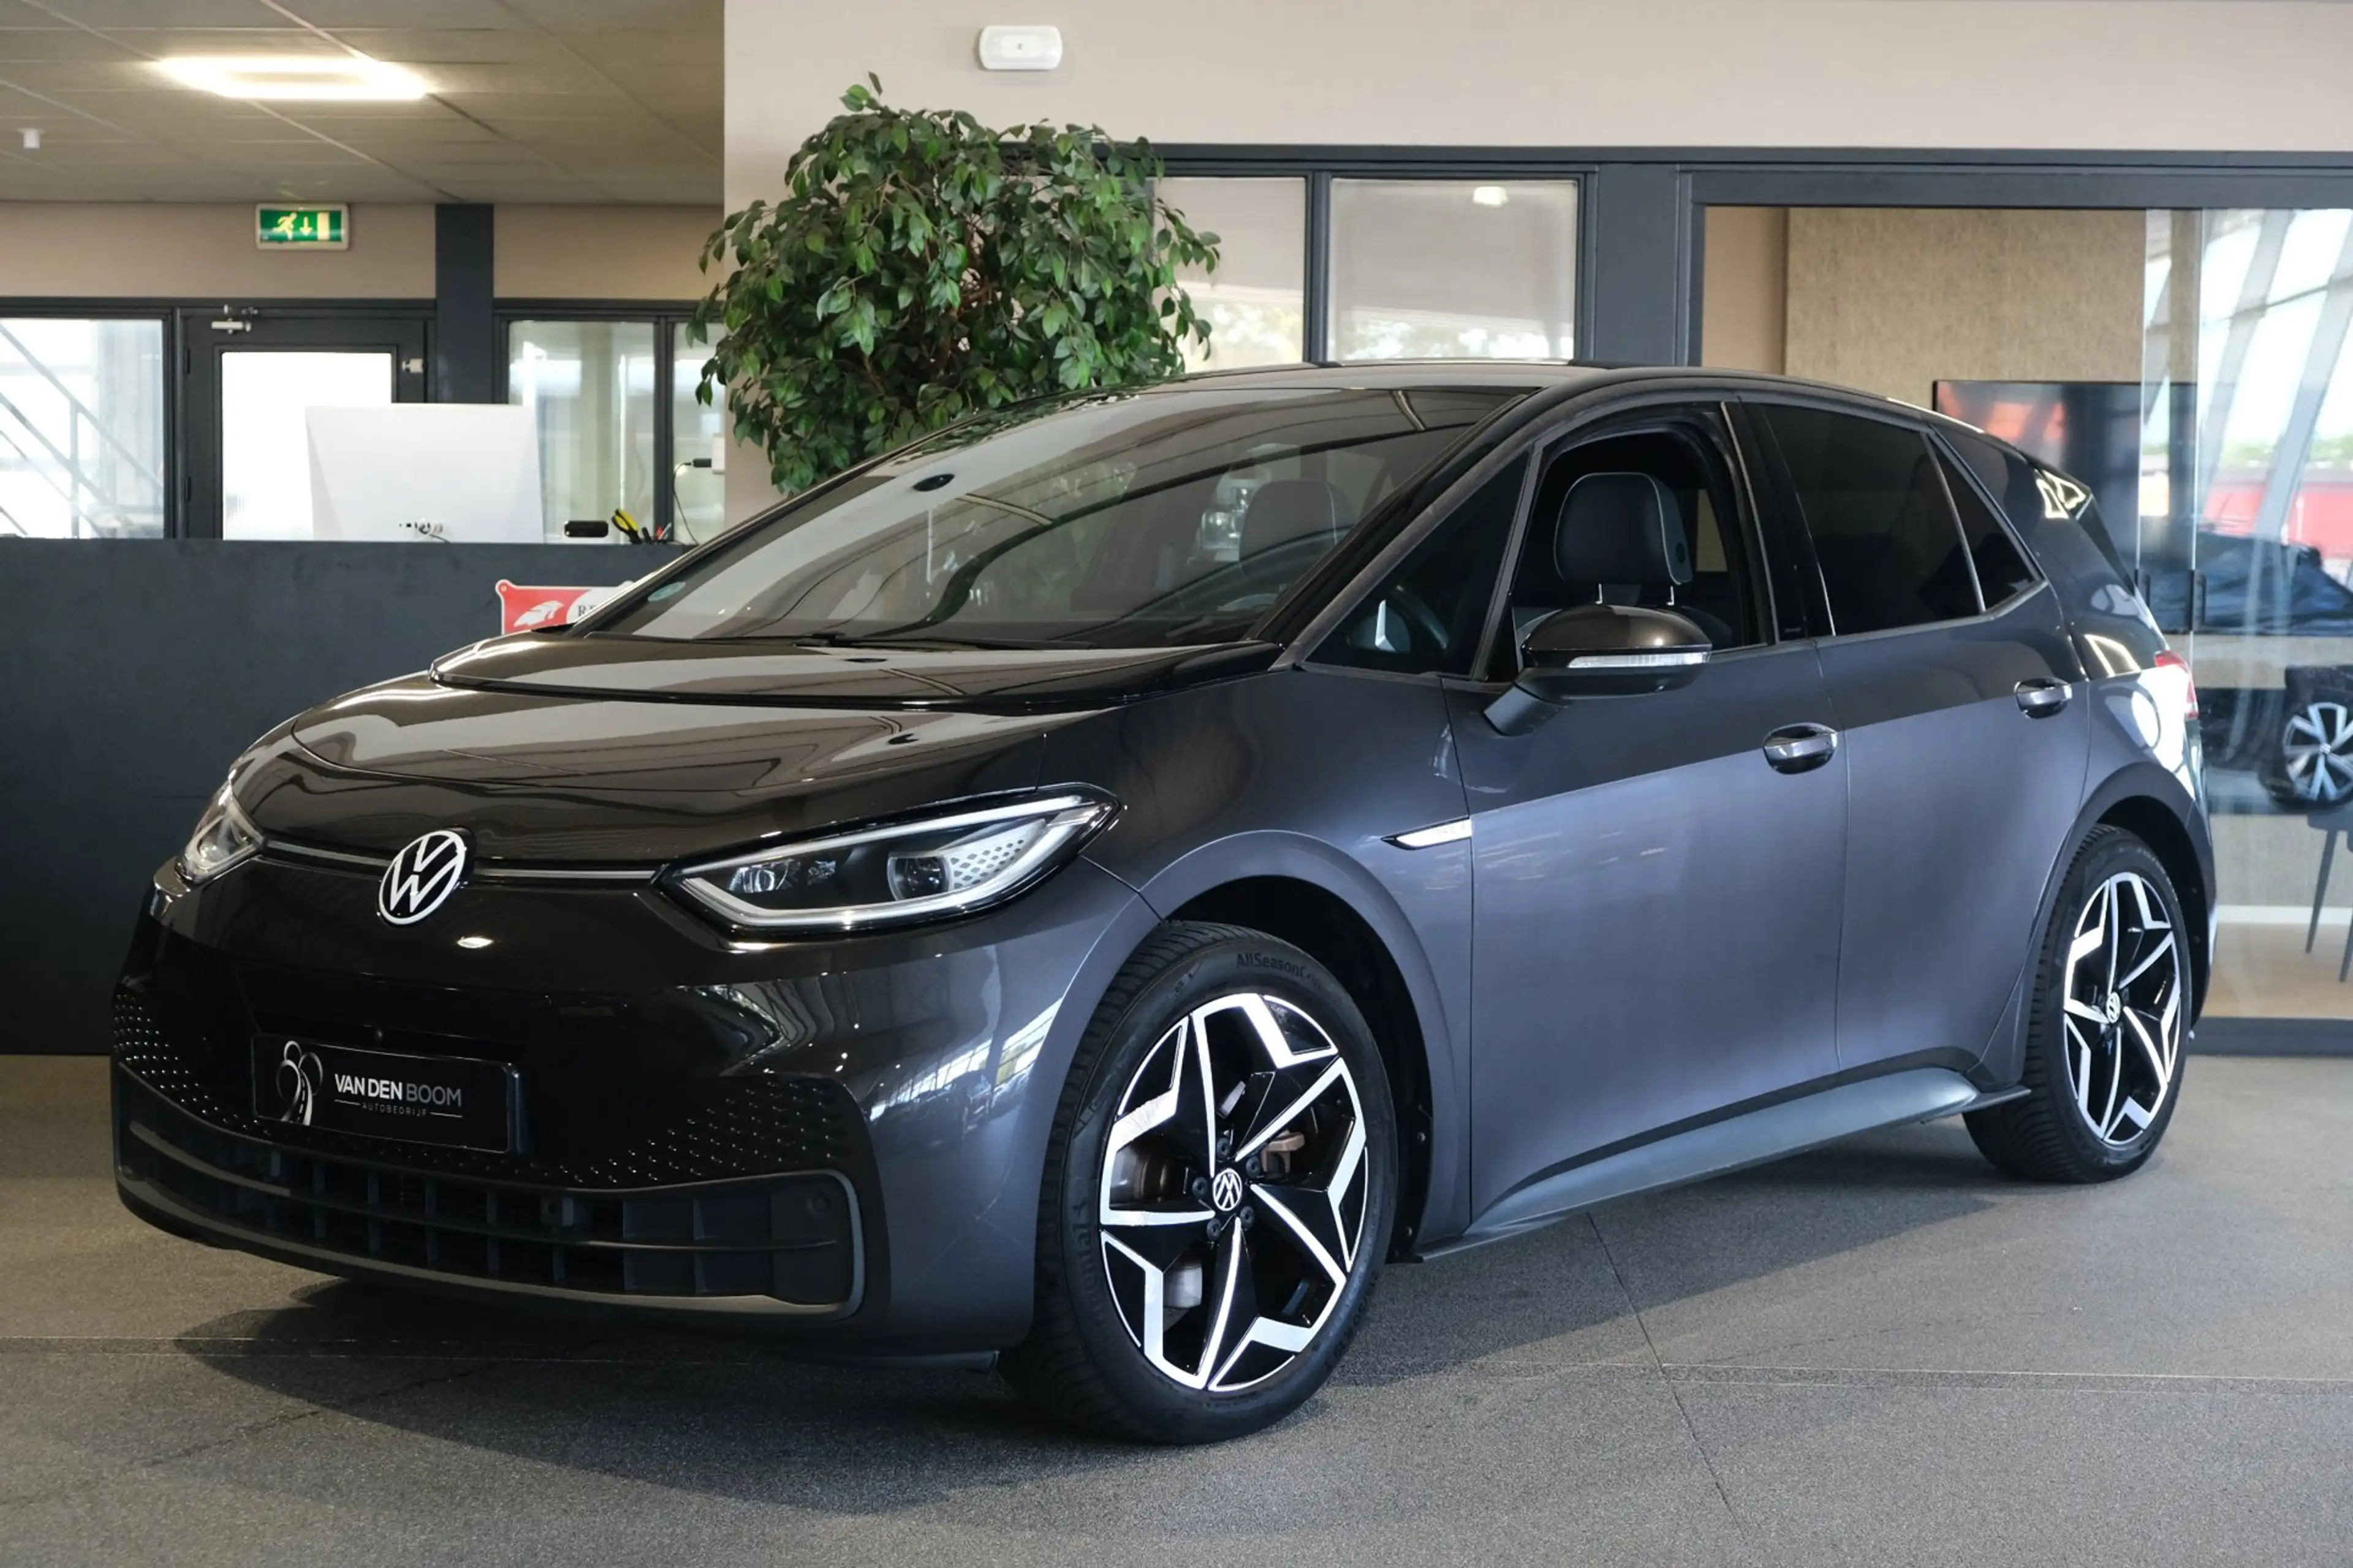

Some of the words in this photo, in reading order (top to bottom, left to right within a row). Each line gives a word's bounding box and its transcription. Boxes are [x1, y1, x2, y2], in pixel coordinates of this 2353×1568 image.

[335, 1074, 365, 1096] VAN
[368, 1078, 402, 1100] DEN
[406, 1083, 461, 1107] BOOM
[362, 1102, 427, 1116] AUTOBEDRIJF
